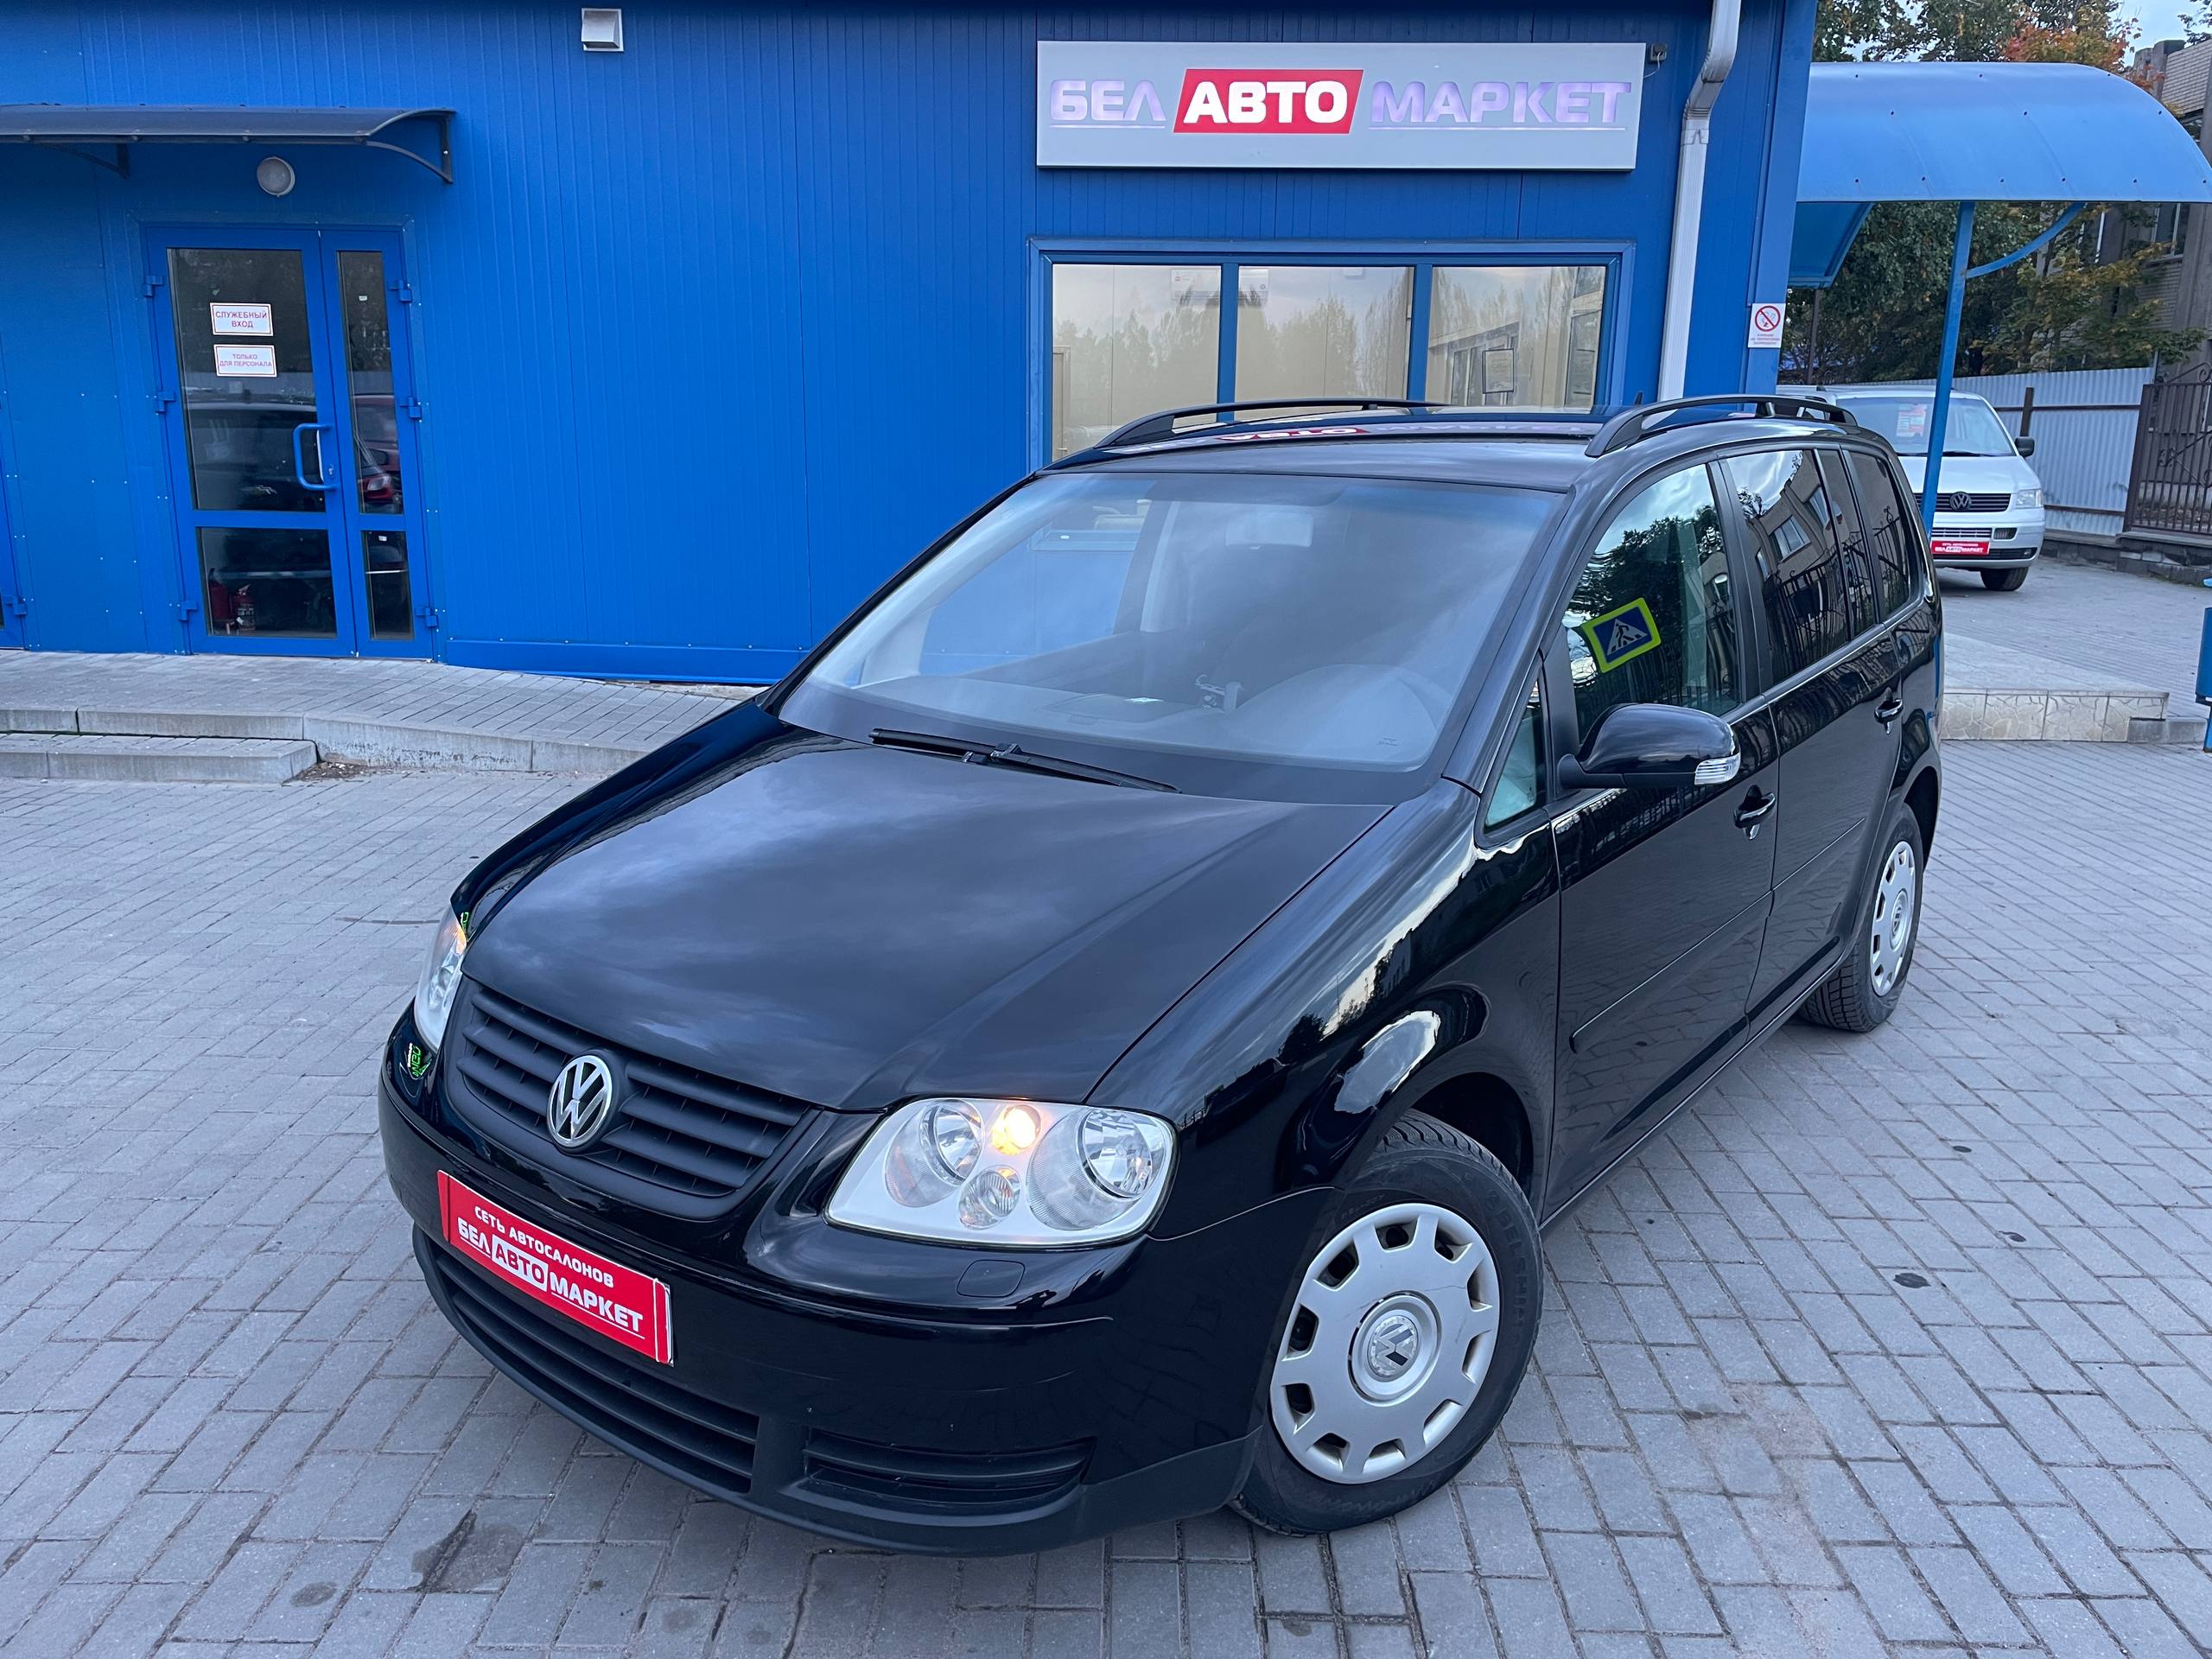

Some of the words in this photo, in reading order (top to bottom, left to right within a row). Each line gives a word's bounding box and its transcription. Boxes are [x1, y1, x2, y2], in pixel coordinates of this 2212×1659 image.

[1050, 79, 1166, 122] БЕЛ
[1182, 80, 1349, 124] АВТО
[1370, 81, 1632, 124] МАРКЕТ
[215, 310, 268, 319] СЛУЖЕБНЫЙ
[547, 1055, 613, 1147] VW
[457, 1217, 491, 1255] БЕЛ
[494, 1244, 547, 1285] АВТО
[550, 1271, 644, 1332] МАРКЕТ
[474, 1205, 505, 1234] СЕТЬ
[508, 1226, 614, 1288] АВТОСАЛОНОВ
